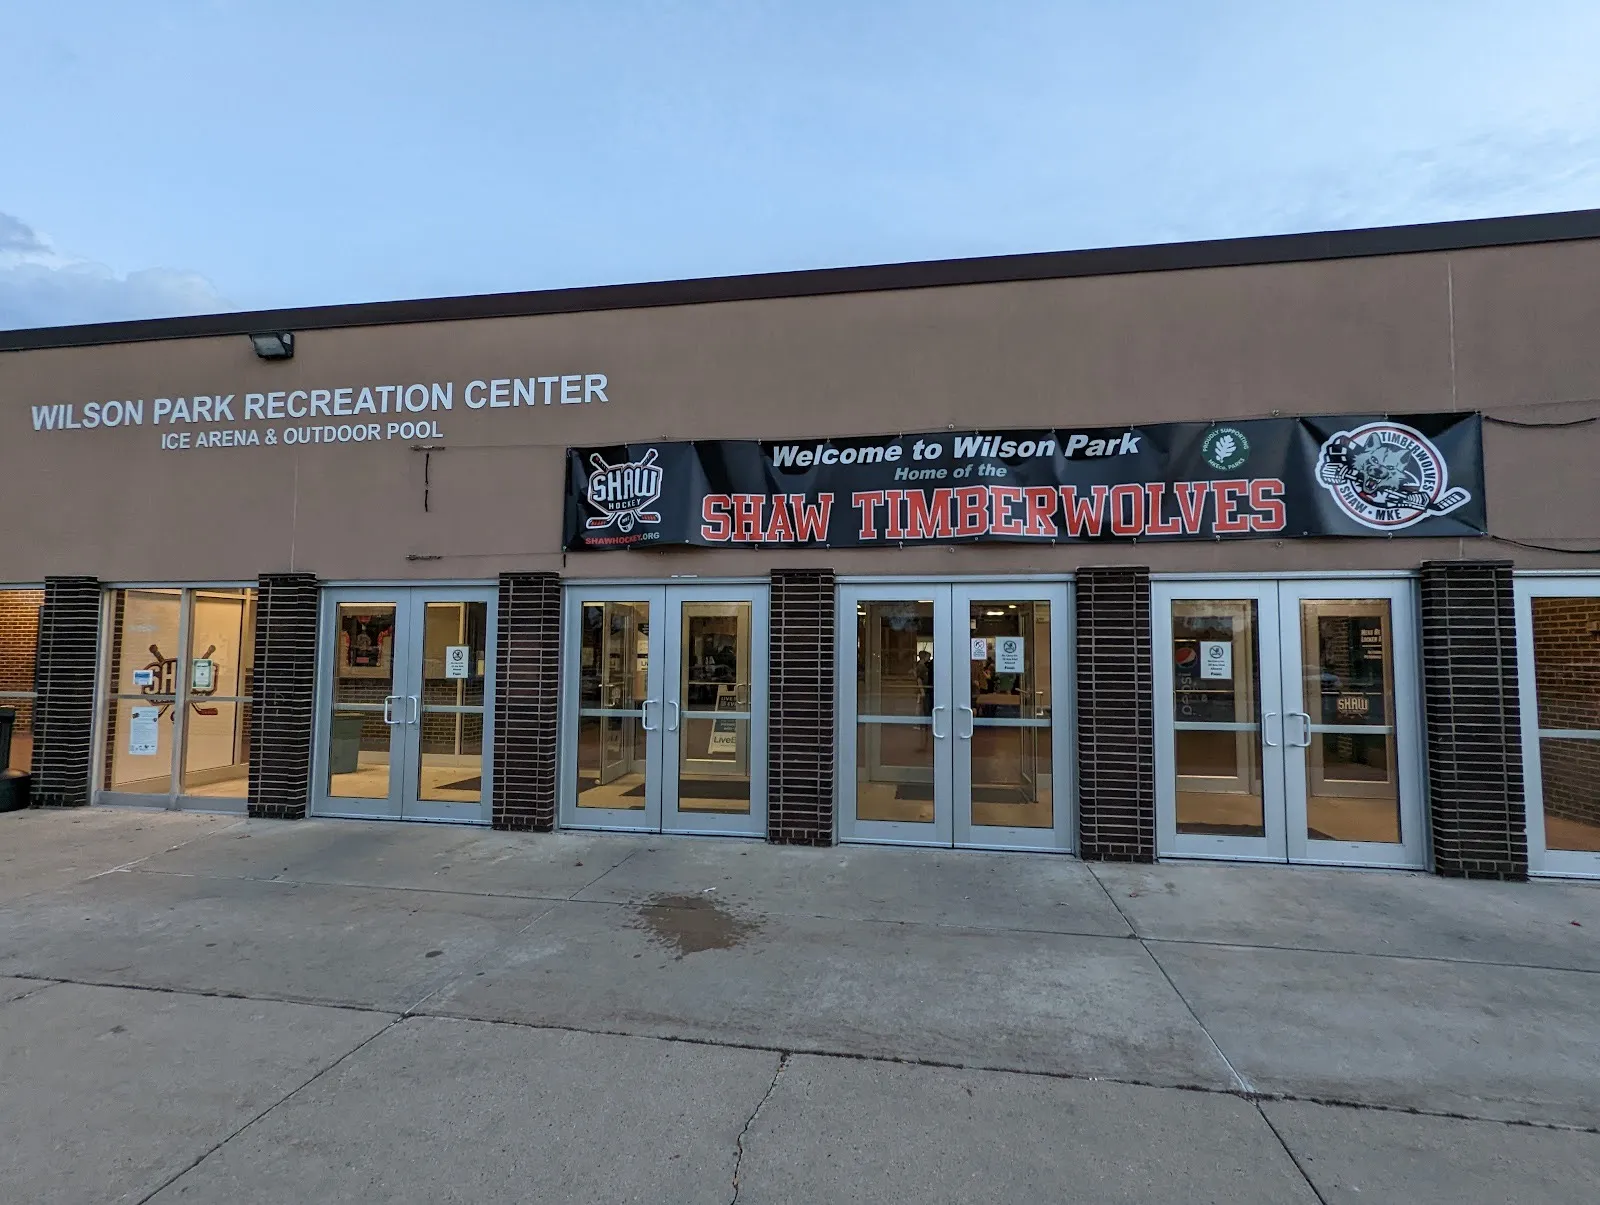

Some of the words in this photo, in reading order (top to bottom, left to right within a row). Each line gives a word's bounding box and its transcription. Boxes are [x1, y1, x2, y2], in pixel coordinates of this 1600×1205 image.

[31, 399, 144, 431] WILSON
[152, 394, 235, 425] PARK
[244, 382, 453, 420] RECREATION
[464, 373, 609, 409] CENTER
[161, 432, 191, 449] ICE
[195, 429, 260, 448] ARENA
[264, 428, 278, 445] &
[283, 423, 381, 445] OUTDOOR
[387, 420, 444, 440] POOL
[1202, 429, 1220, 452] PROUDLY
[1220, 428, 1249, 450] SUPPORTING
[772, 443, 903, 468] Welcome
[912, 439, 943, 461] to
[953, 435, 1056, 459] Wilson
[1064, 431, 1141, 457] Park
[1228, 457, 1245, 469] PARKS
[1380, 430, 1437, 493] TIMBERWOLVES
[592, 467, 658, 502] SHAW
[894, 466, 947, 481] Home
[953, 463, 973, 479] of
[978, 462, 1007, 478] the
[608, 498, 641, 510] HOCKEY
[700, 492, 835, 543] SHAW
[852, 478, 1287, 541] TIMBERWOLVES
[1339, 483, 1368, 514] SHAW
[1375, 508, 1402, 521] MKE
[585, 532, 660, 545] SHAWHOCKEY.ORG
[1338, 697, 1368, 710] SHAW
